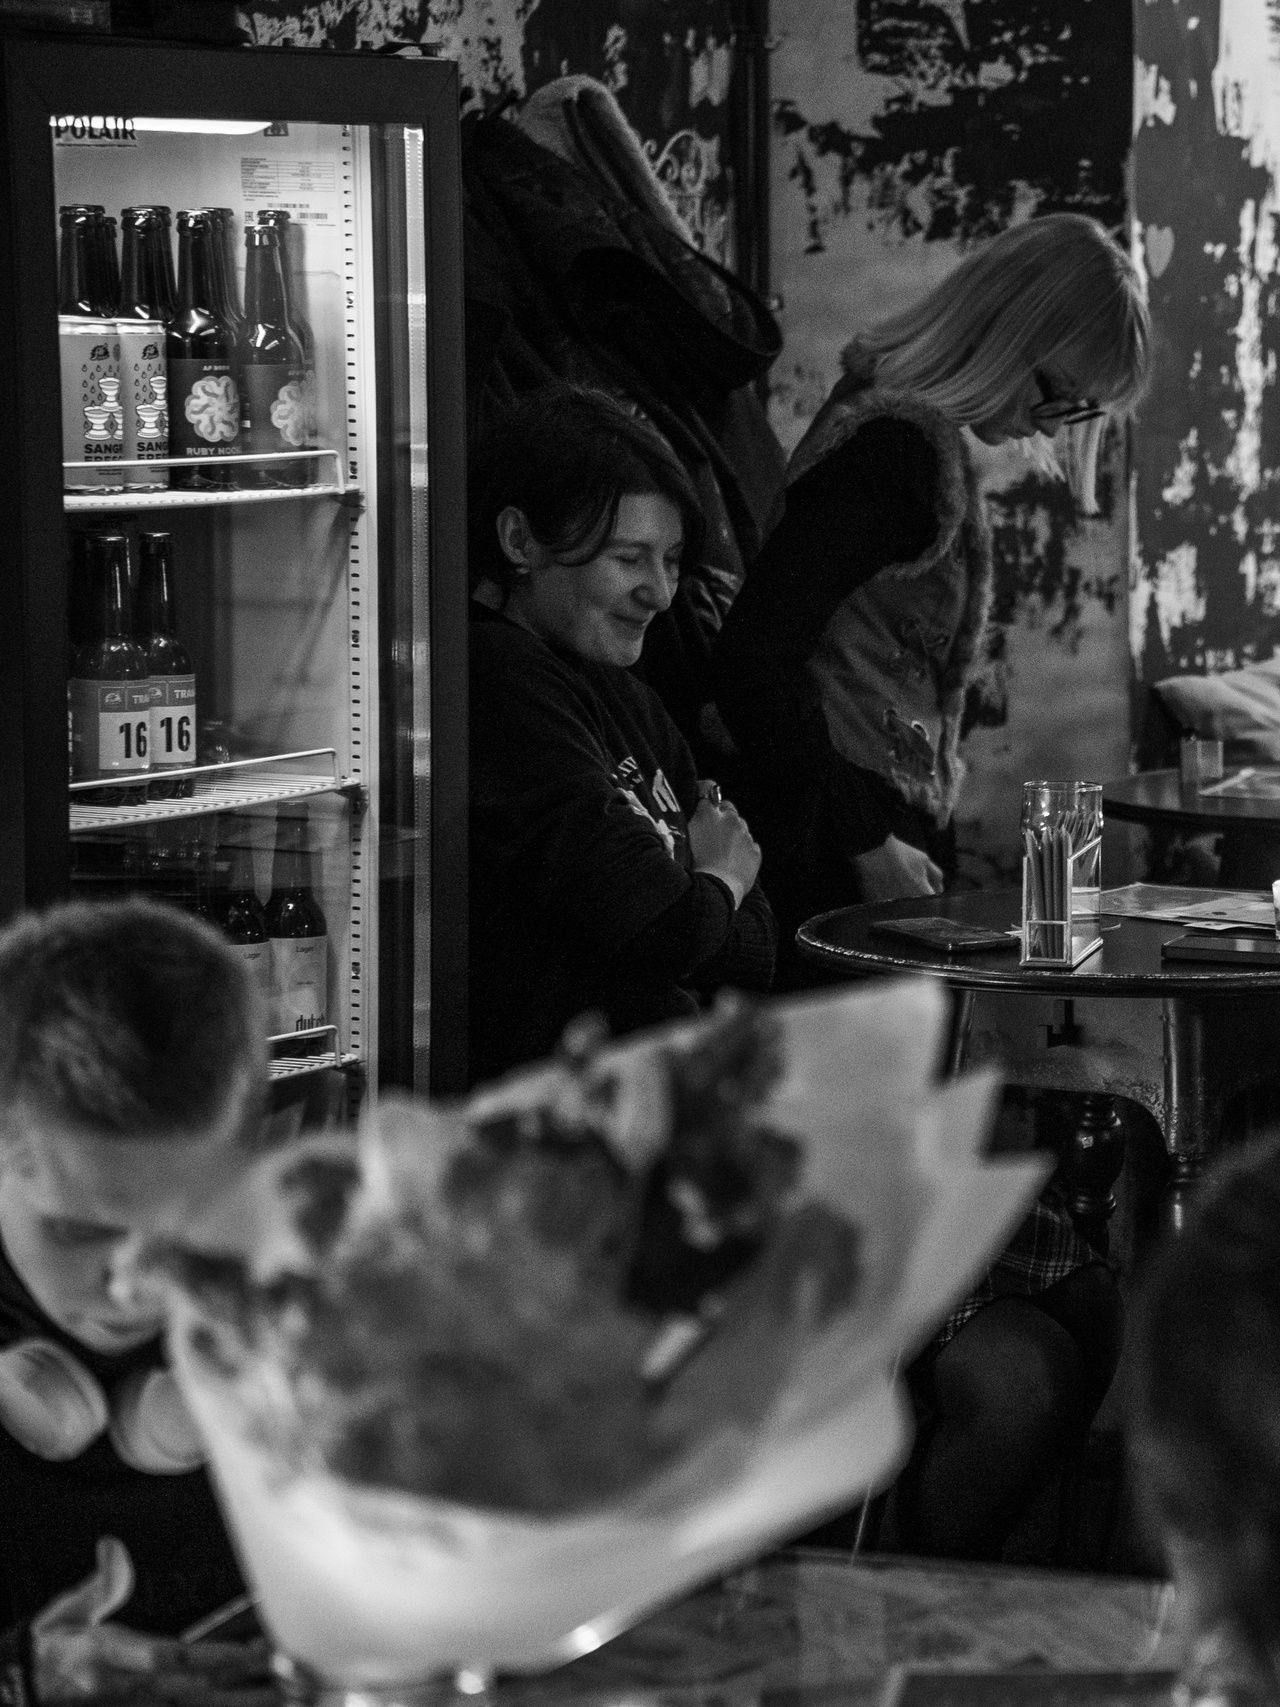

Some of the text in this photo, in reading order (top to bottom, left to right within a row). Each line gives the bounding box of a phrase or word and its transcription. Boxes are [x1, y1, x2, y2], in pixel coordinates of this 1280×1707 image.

[55, 116, 136, 140] POLAIR
[186, 447, 215, 456] RUBY
[119, 721, 147, 759] 16
[160, 715, 191, 753] 16
